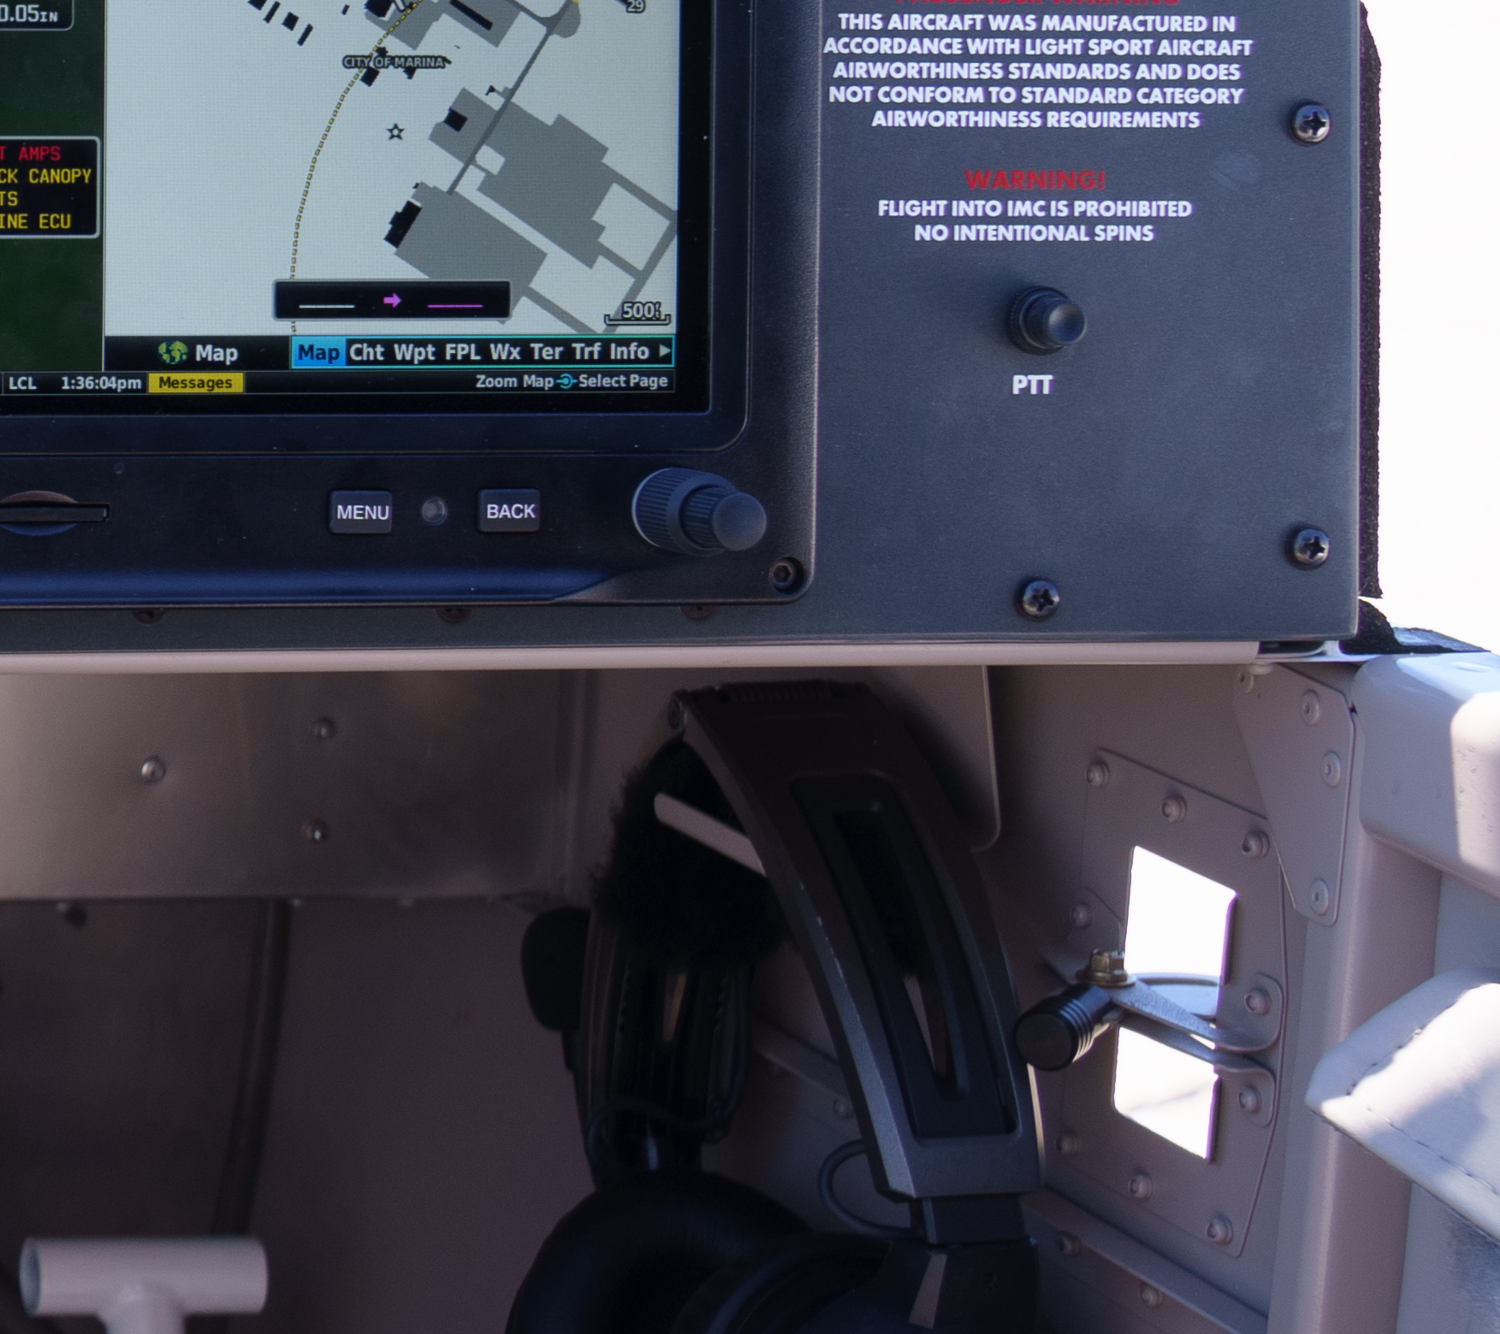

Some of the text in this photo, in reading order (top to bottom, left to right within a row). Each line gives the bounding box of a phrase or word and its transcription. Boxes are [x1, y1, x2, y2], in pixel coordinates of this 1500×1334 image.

[838, 13, 1235, 32] THIS AIRCRAFT WAS MANUFACTURED IN
[966, 170, 1104, 189] WARNING!
[915, 225, 1154, 241] NO INTENTIONAL SPINS
[350, 342, 649, 364] Cht Wpt FPL Wx Ter Trf Info
[476, 374, 668, 392] Zoom Map Select Page
[1013, 375, 1053, 394] PTT
[338, 505, 389, 520] MENU
[487, 504, 535, 519] BACK
